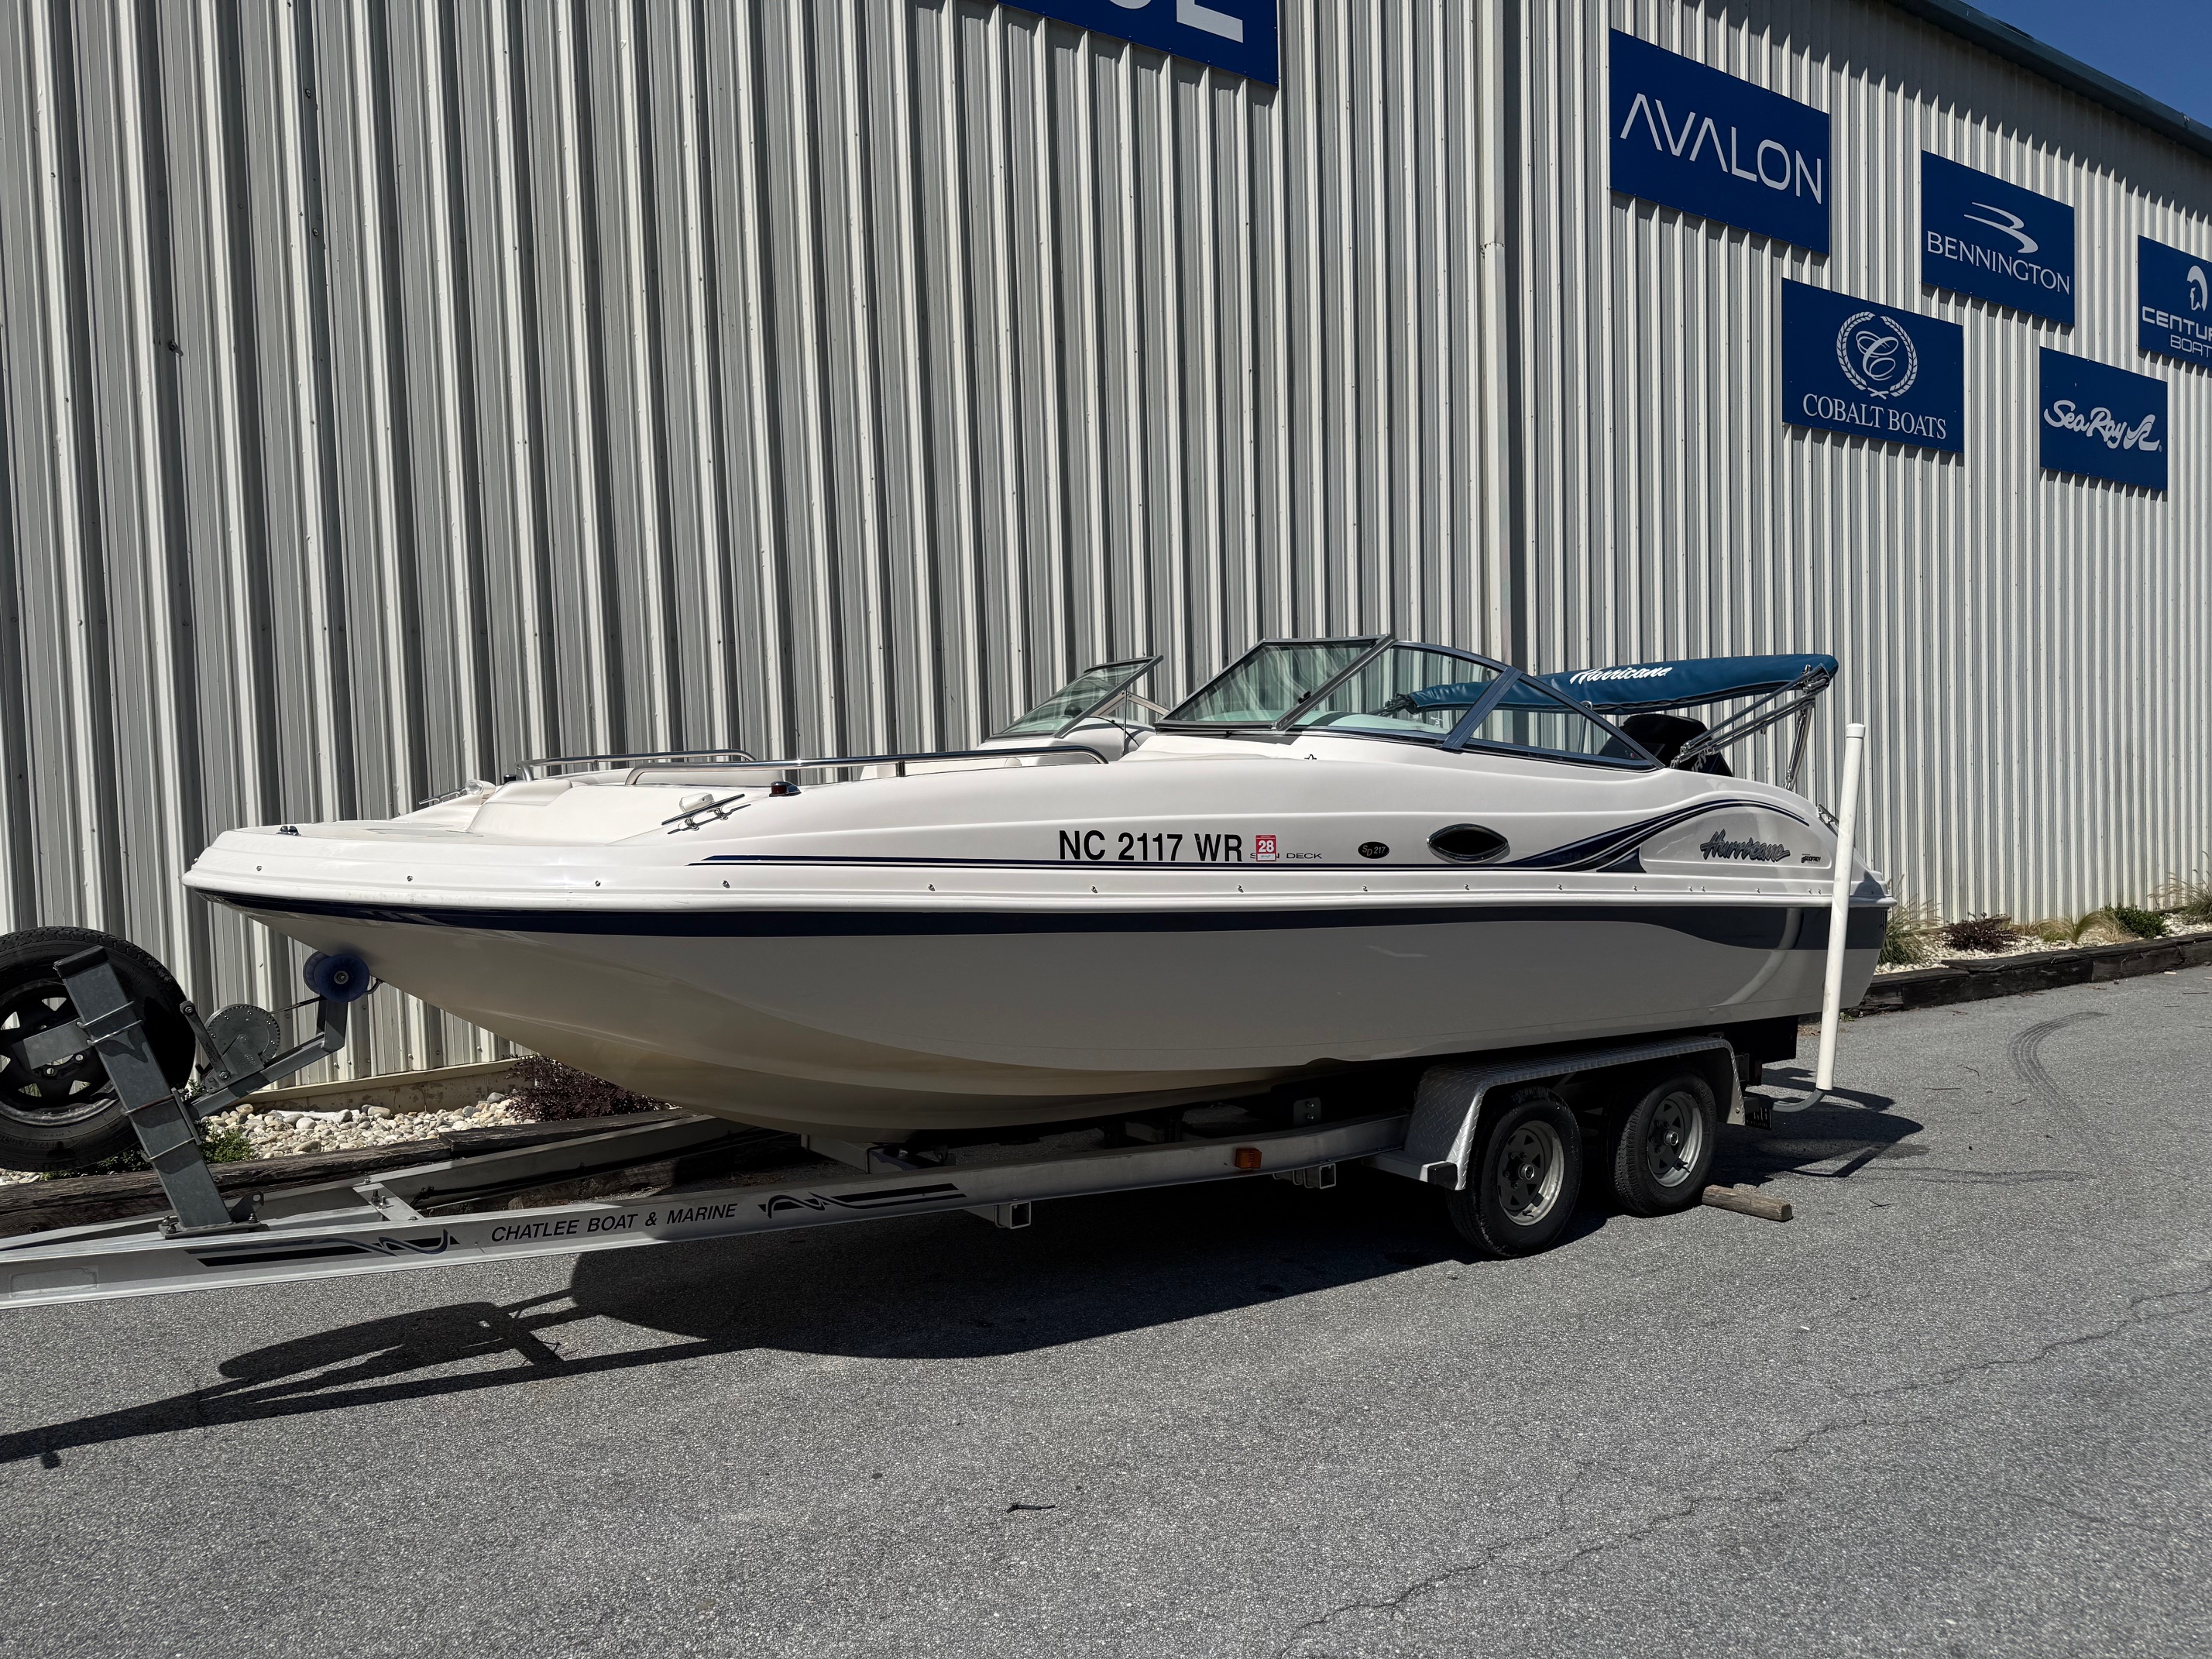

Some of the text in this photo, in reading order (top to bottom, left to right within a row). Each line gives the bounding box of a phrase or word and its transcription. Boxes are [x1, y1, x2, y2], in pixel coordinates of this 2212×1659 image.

[1620, 92, 1822, 204] AVALON
[1926, 230, 2070, 296] BENNINGTON
[1802, 393, 1946, 439] COBALT BOATS
[1569, 665, 1673, 685] Hurricane
[1059, 830, 1242, 862] NC 2117 WR
[1258, 840, 1275, 853] 28
[1373, 846, 1386, 854] 217
[1699, 828, 1791, 863] Hurricane
[491, 1203, 738, 1242] CHATLEE BOAT & MARINE
